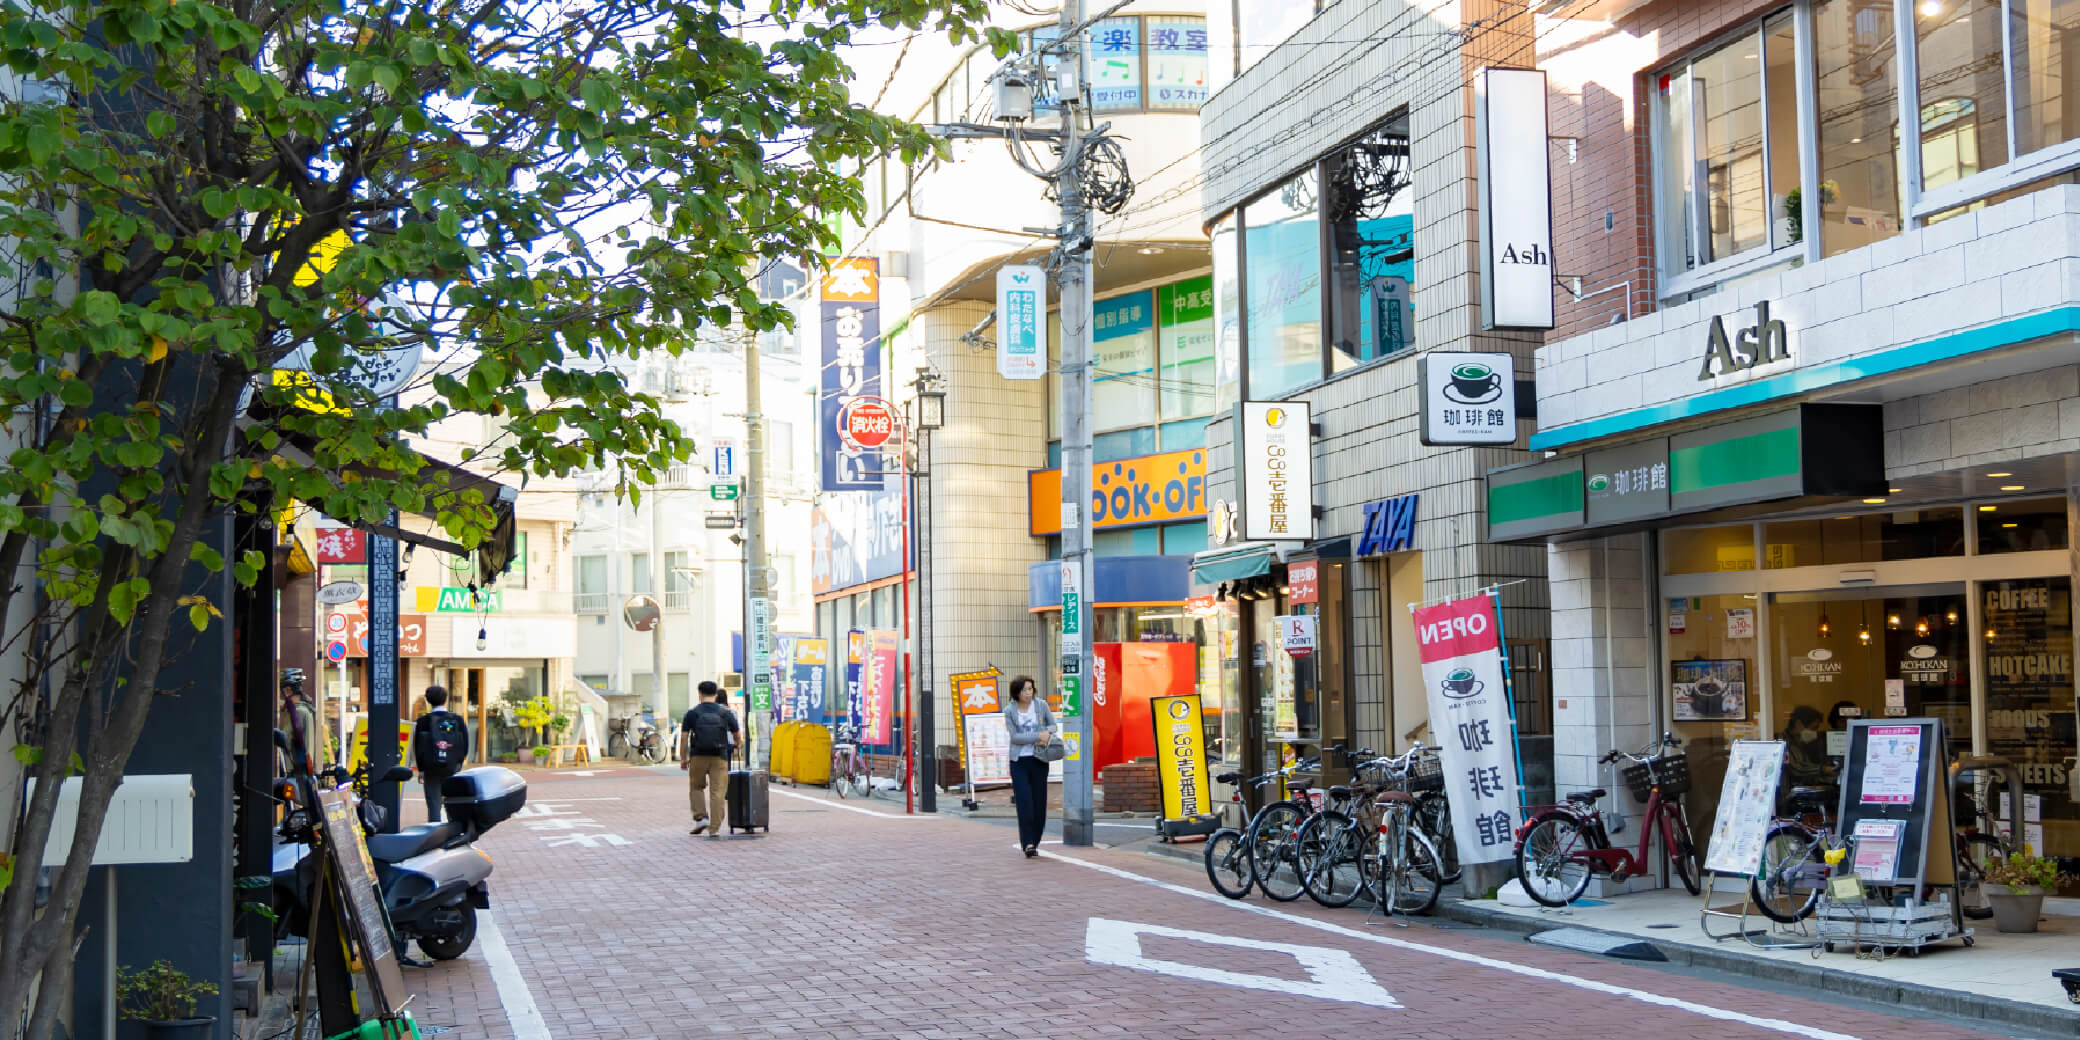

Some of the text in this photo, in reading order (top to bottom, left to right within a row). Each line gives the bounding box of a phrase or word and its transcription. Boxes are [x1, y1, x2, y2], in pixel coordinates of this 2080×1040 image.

[1090, 28, 1207, 51] 楽教室
[1500, 243, 1548, 265] Ash
[828, 265, 871, 297] 本
[1095, 305, 1142, 329] 個別指導
[1698, 300, 1791, 381] Ash
[836, 306, 865, 482] お売りい
[852, 416, 889, 433] 消火栓
[1444, 409, 1504, 426] 珈琲館
[1267, 445, 1288, 534] CoCo壱番屋
[1615, 463, 1666, 495] 珈琲館
[1357, 495, 1418, 555] TAYA
[1291, 586, 1314, 599] コーナー
[1986, 588, 2048, 609] COFFEE
[798, 644, 825, 659] ゲーム
[1287, 637, 1312, 645] POINT
[1989, 655, 2071, 676] HOTCAKE
[962, 683, 996, 709] 本
[1991, 709, 2050, 728] FOODS
[1173, 733, 1199, 817] CoCo壱番屋
